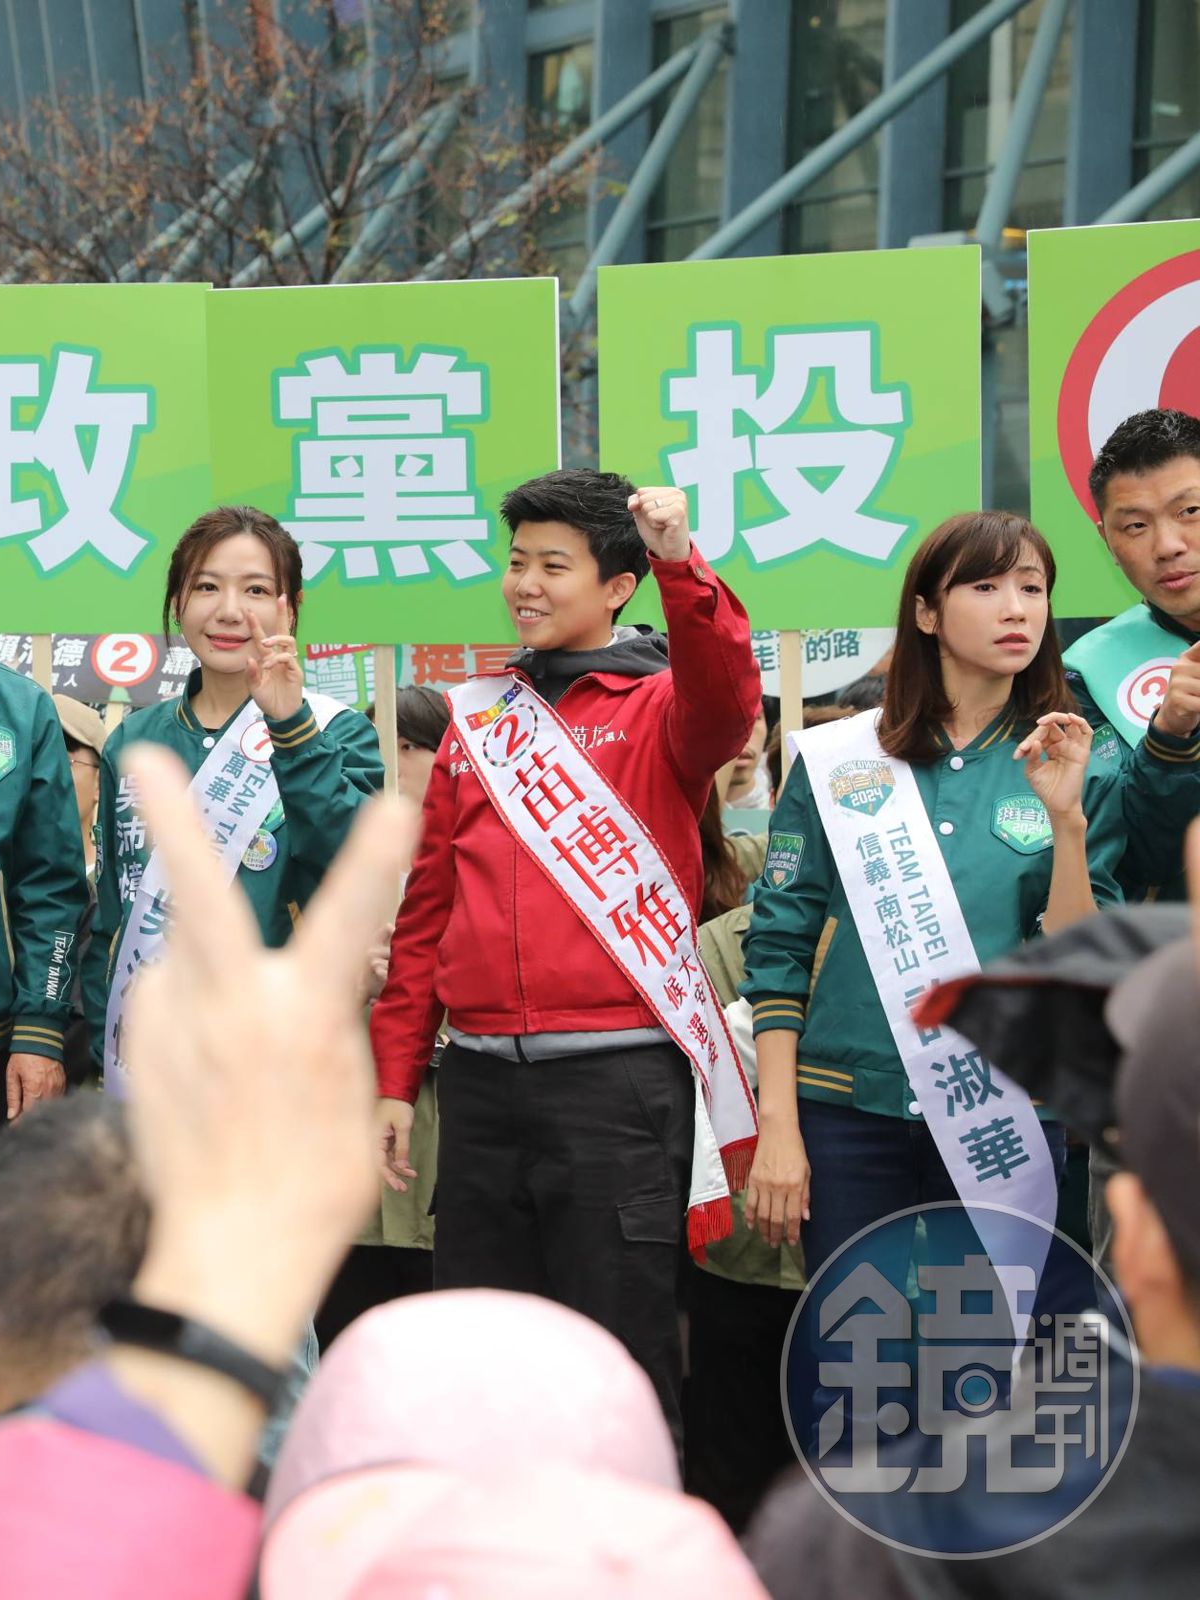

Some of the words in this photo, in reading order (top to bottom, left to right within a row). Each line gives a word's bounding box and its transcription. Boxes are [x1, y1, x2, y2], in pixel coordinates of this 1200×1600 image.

[109, 641, 139, 673] 2
[753, 630, 861, 672] 走的路
[465, 683, 524, 731] TAIWAN
[494, 714, 529, 758] 2
[227, 764, 272, 817] TEAM
[850, 787, 884, 807] 2024
[508, 745, 689, 968] 苗博雅
[887, 821, 924, 883] TEAM
[907, 885, 950, 961] TAIPEI
[51, 936, 67, 964] TEAM
